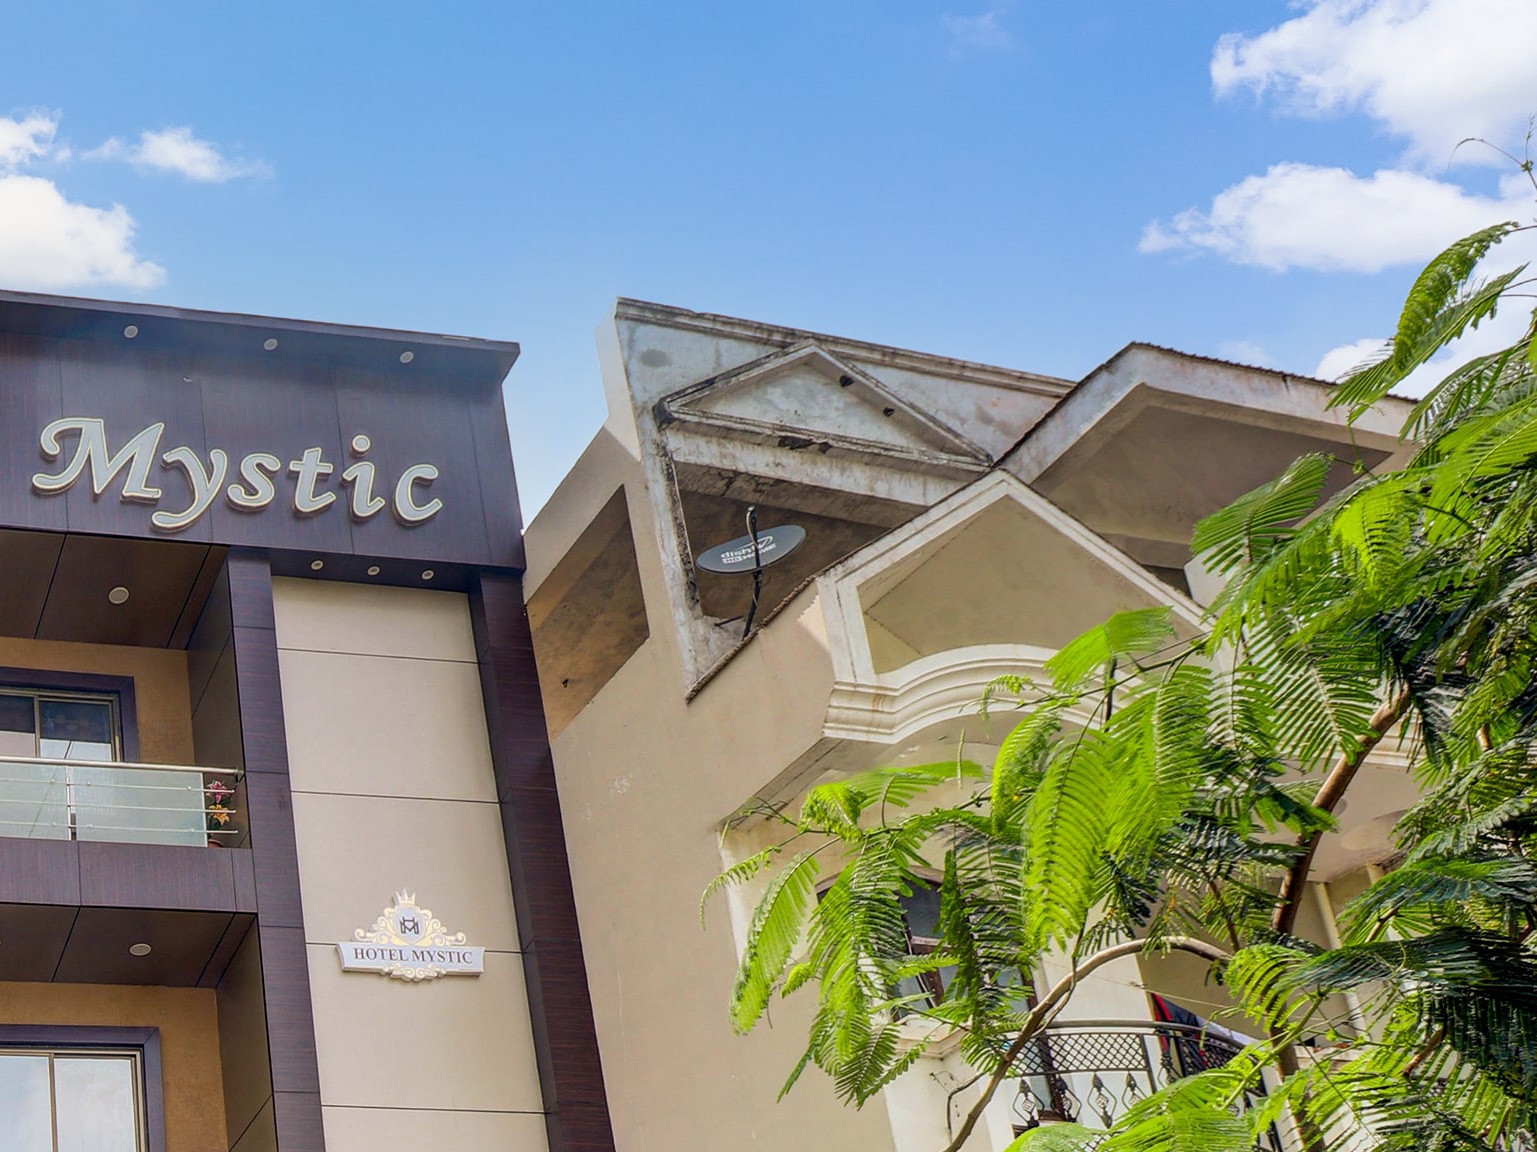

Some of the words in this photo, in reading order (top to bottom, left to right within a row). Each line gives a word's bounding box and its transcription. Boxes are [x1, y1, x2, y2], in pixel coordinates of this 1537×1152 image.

[30, 416, 443, 532] Mystic
[353, 947, 408, 962] HOTEL
[412, 949, 474, 964] MYSTIC
